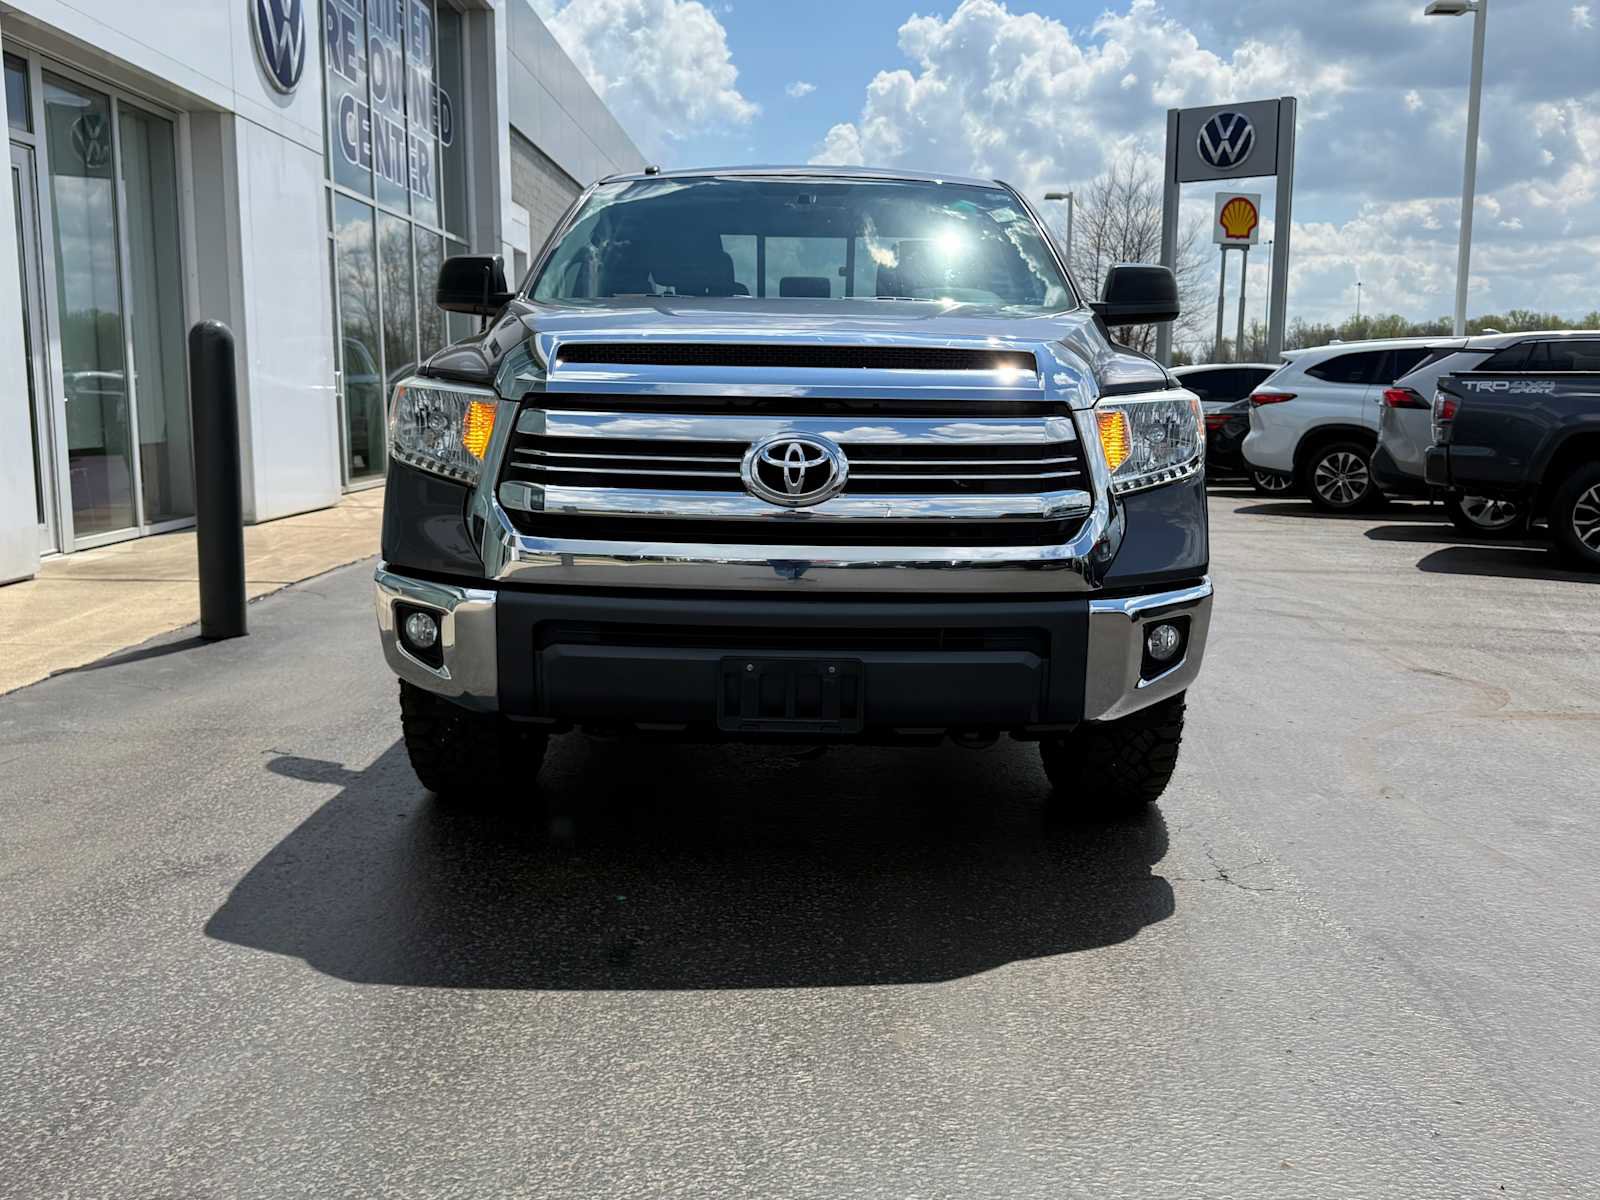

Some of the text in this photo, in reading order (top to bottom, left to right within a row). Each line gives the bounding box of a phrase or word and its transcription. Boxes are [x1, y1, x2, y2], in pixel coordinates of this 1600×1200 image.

[338, 92, 434, 202] CENTER
[1200, 112, 1254, 166] VW
[1462, 381, 1510, 392] TRD
